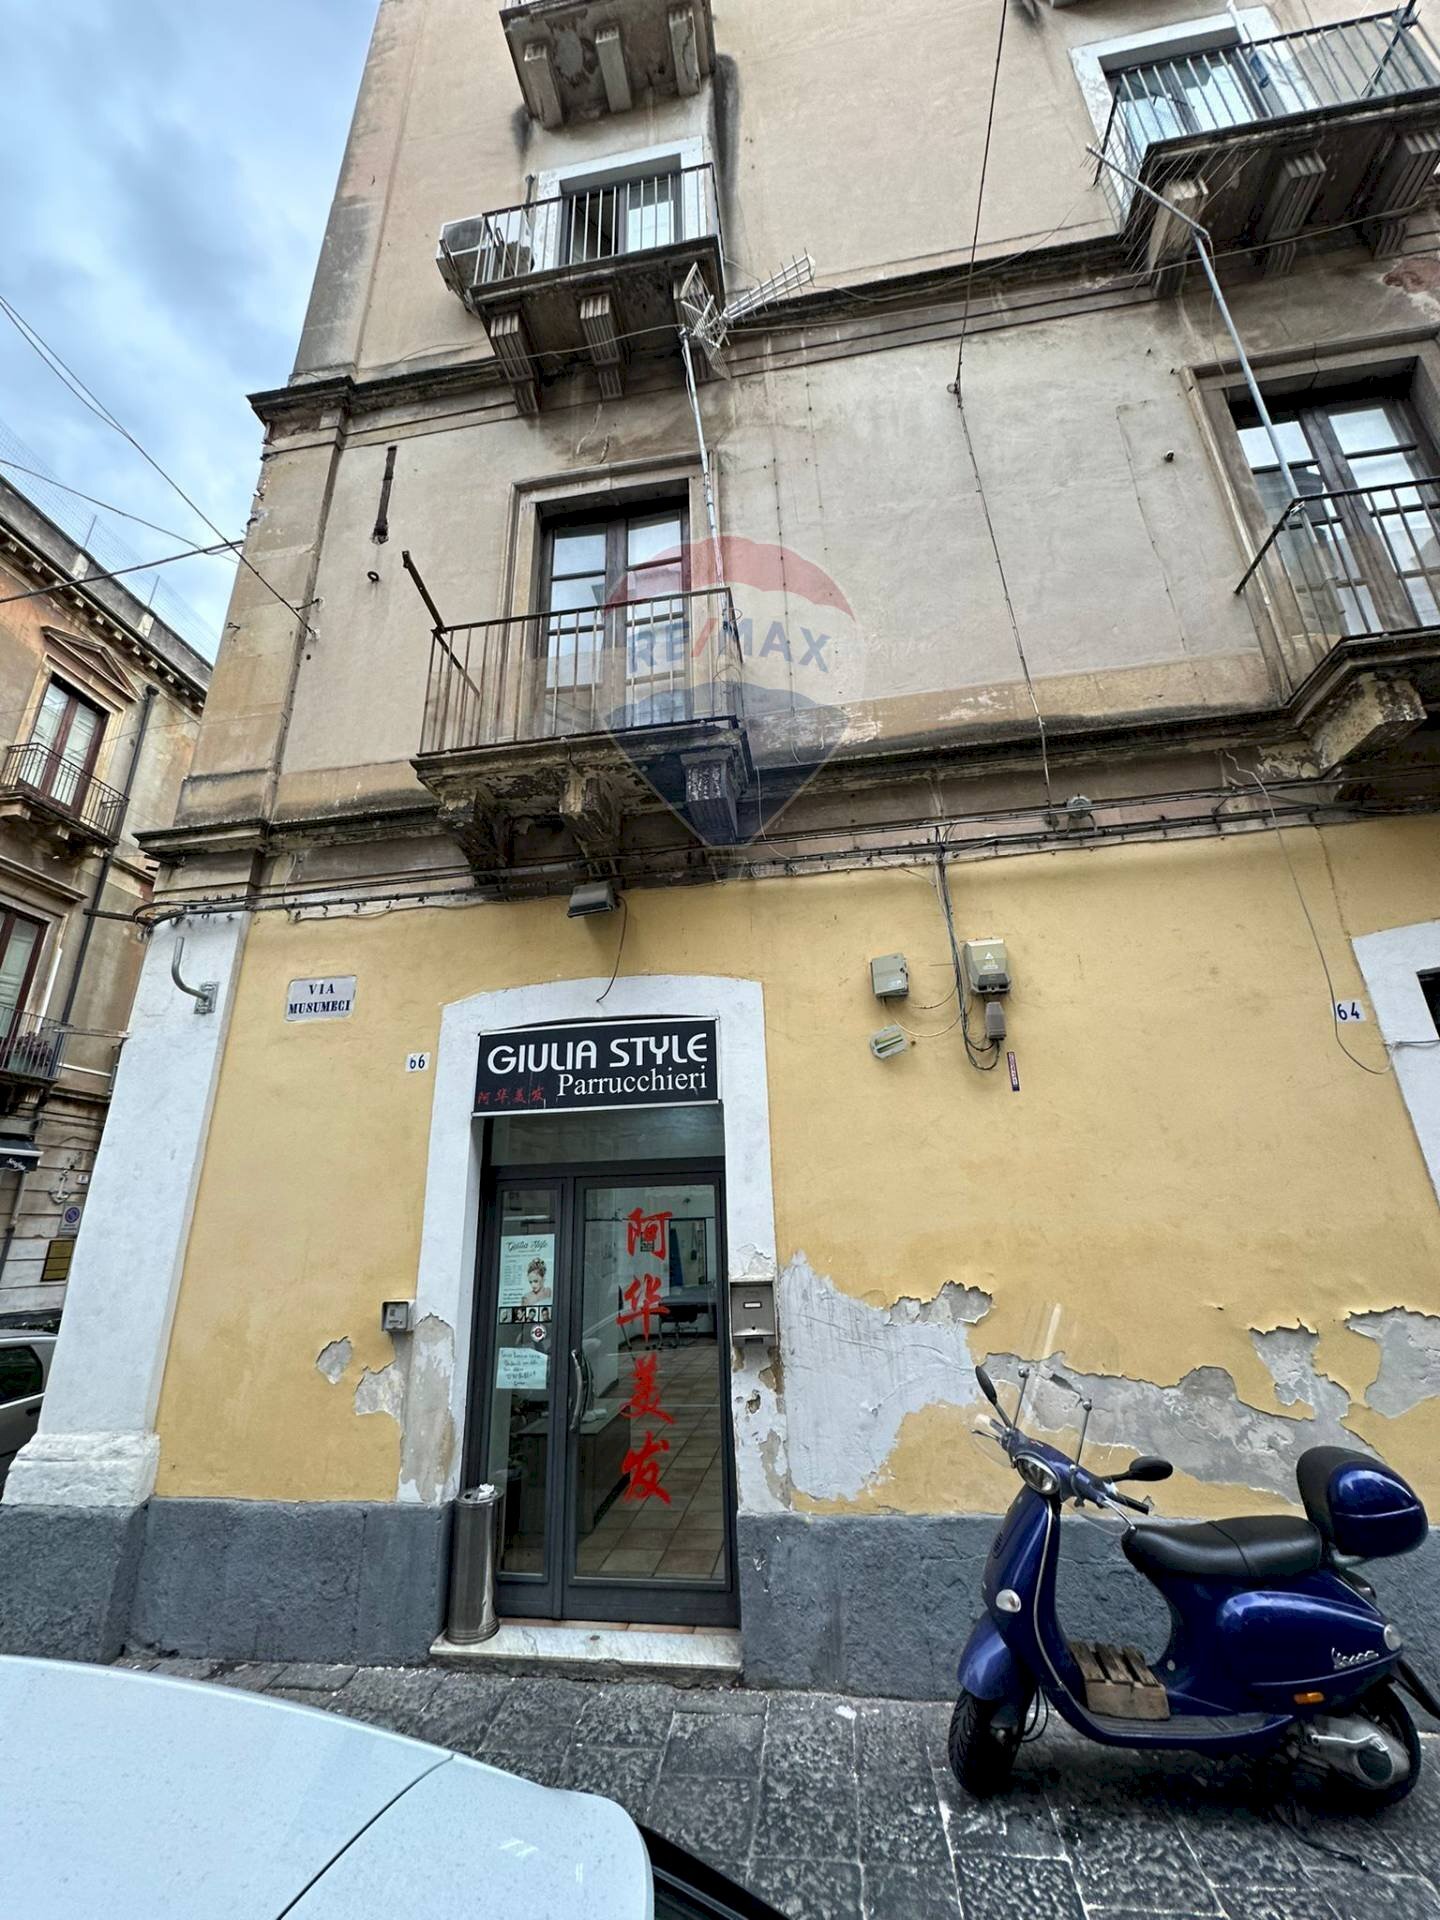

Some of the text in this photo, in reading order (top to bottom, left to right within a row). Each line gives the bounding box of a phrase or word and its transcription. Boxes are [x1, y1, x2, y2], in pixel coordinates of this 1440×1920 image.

[309, 983, 335, 995] VIA
[288, 999, 352, 1015] MUSUMECI
[1336, 1001, 1361, 1021] 64
[409, 1054, 426, 1070] 66
[487, 1032, 708, 1074] GIULIA STYLE
[556, 1064, 707, 1097] Parrucchieri
[616, 1207, 678, 1507] 阿华美发
